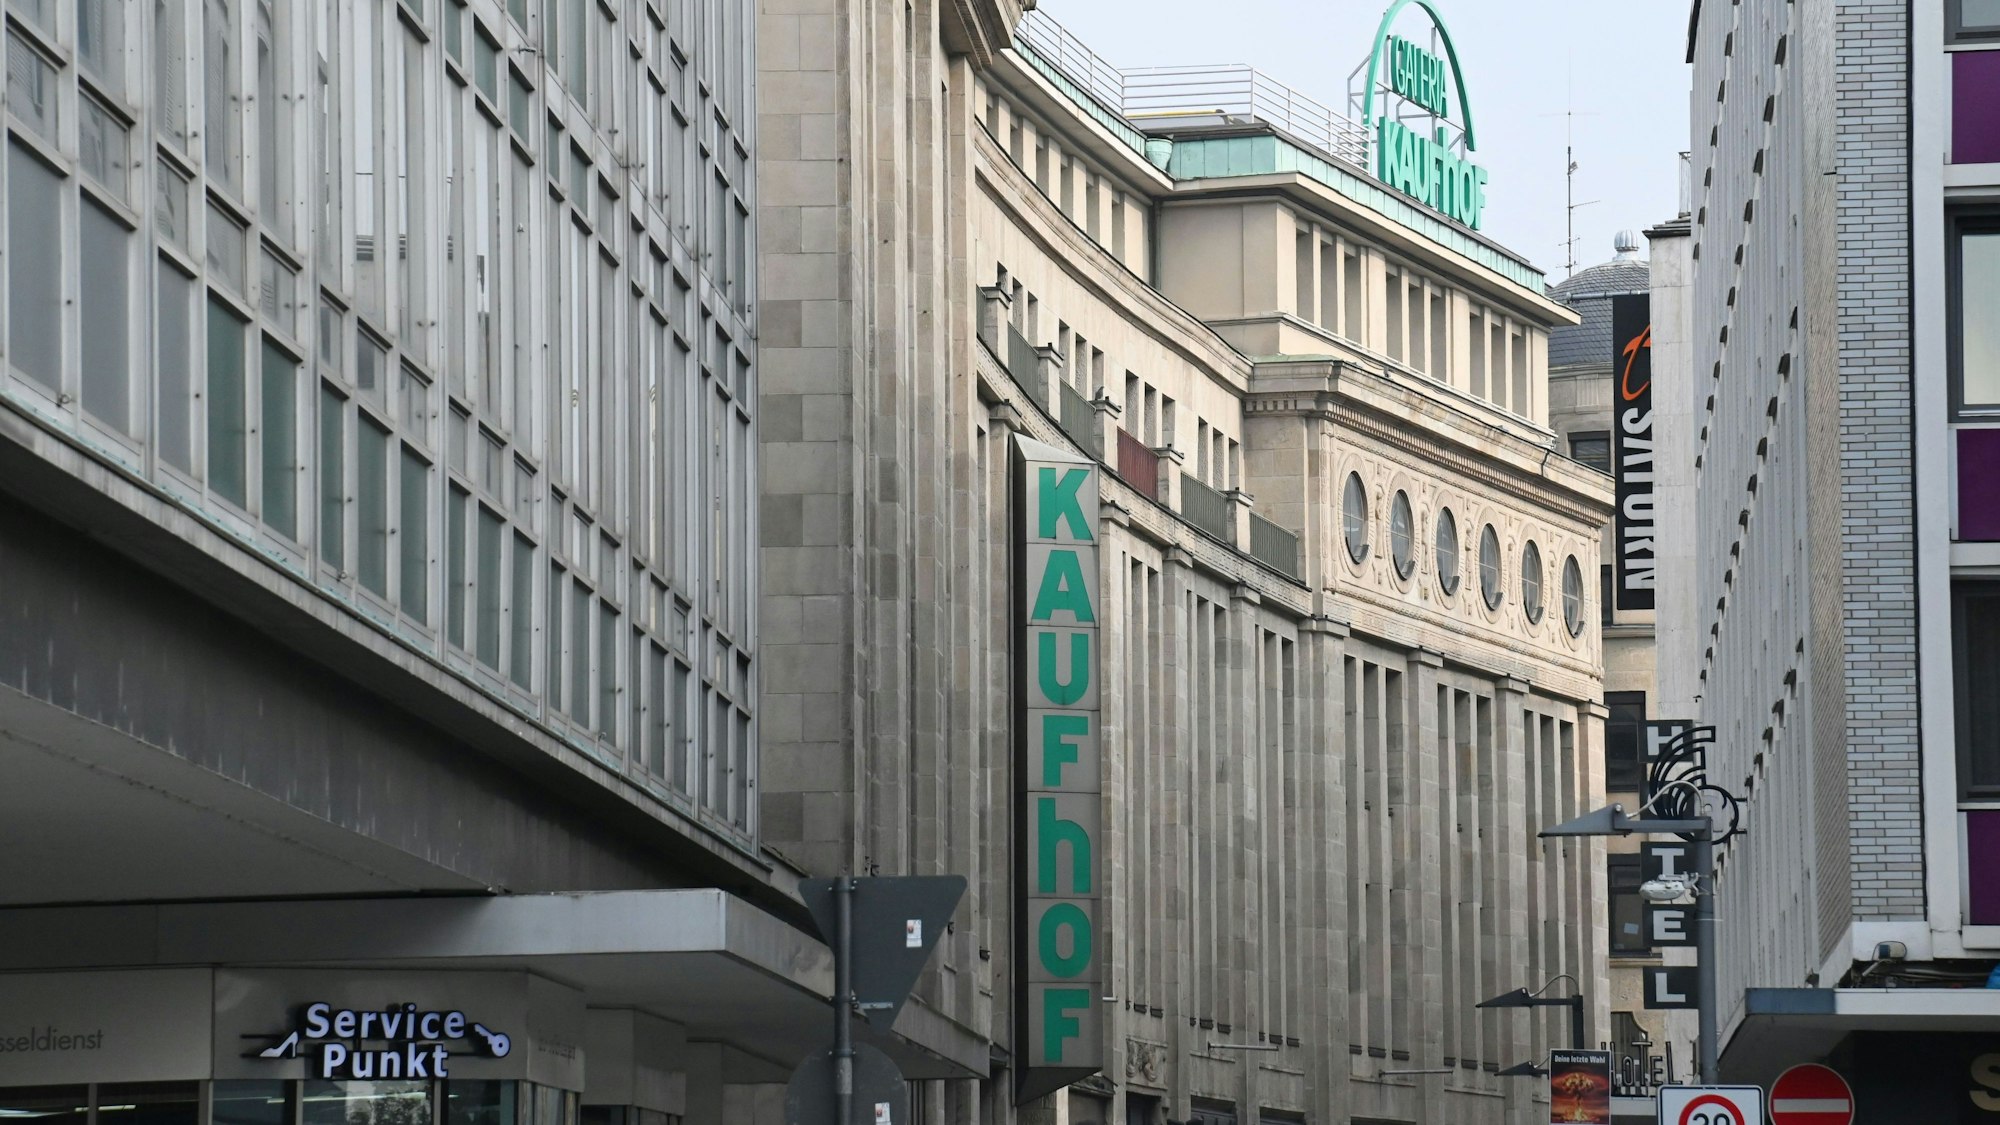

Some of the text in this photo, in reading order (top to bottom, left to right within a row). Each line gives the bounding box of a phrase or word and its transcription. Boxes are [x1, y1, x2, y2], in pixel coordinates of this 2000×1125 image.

[1390, 34, 1448, 118] GALERIA
[305, 1002, 467, 1040] Service
[321, 1042, 450, 1079] Punkt
[1554, 1055, 1606, 1064] Deine letzte Wahl
